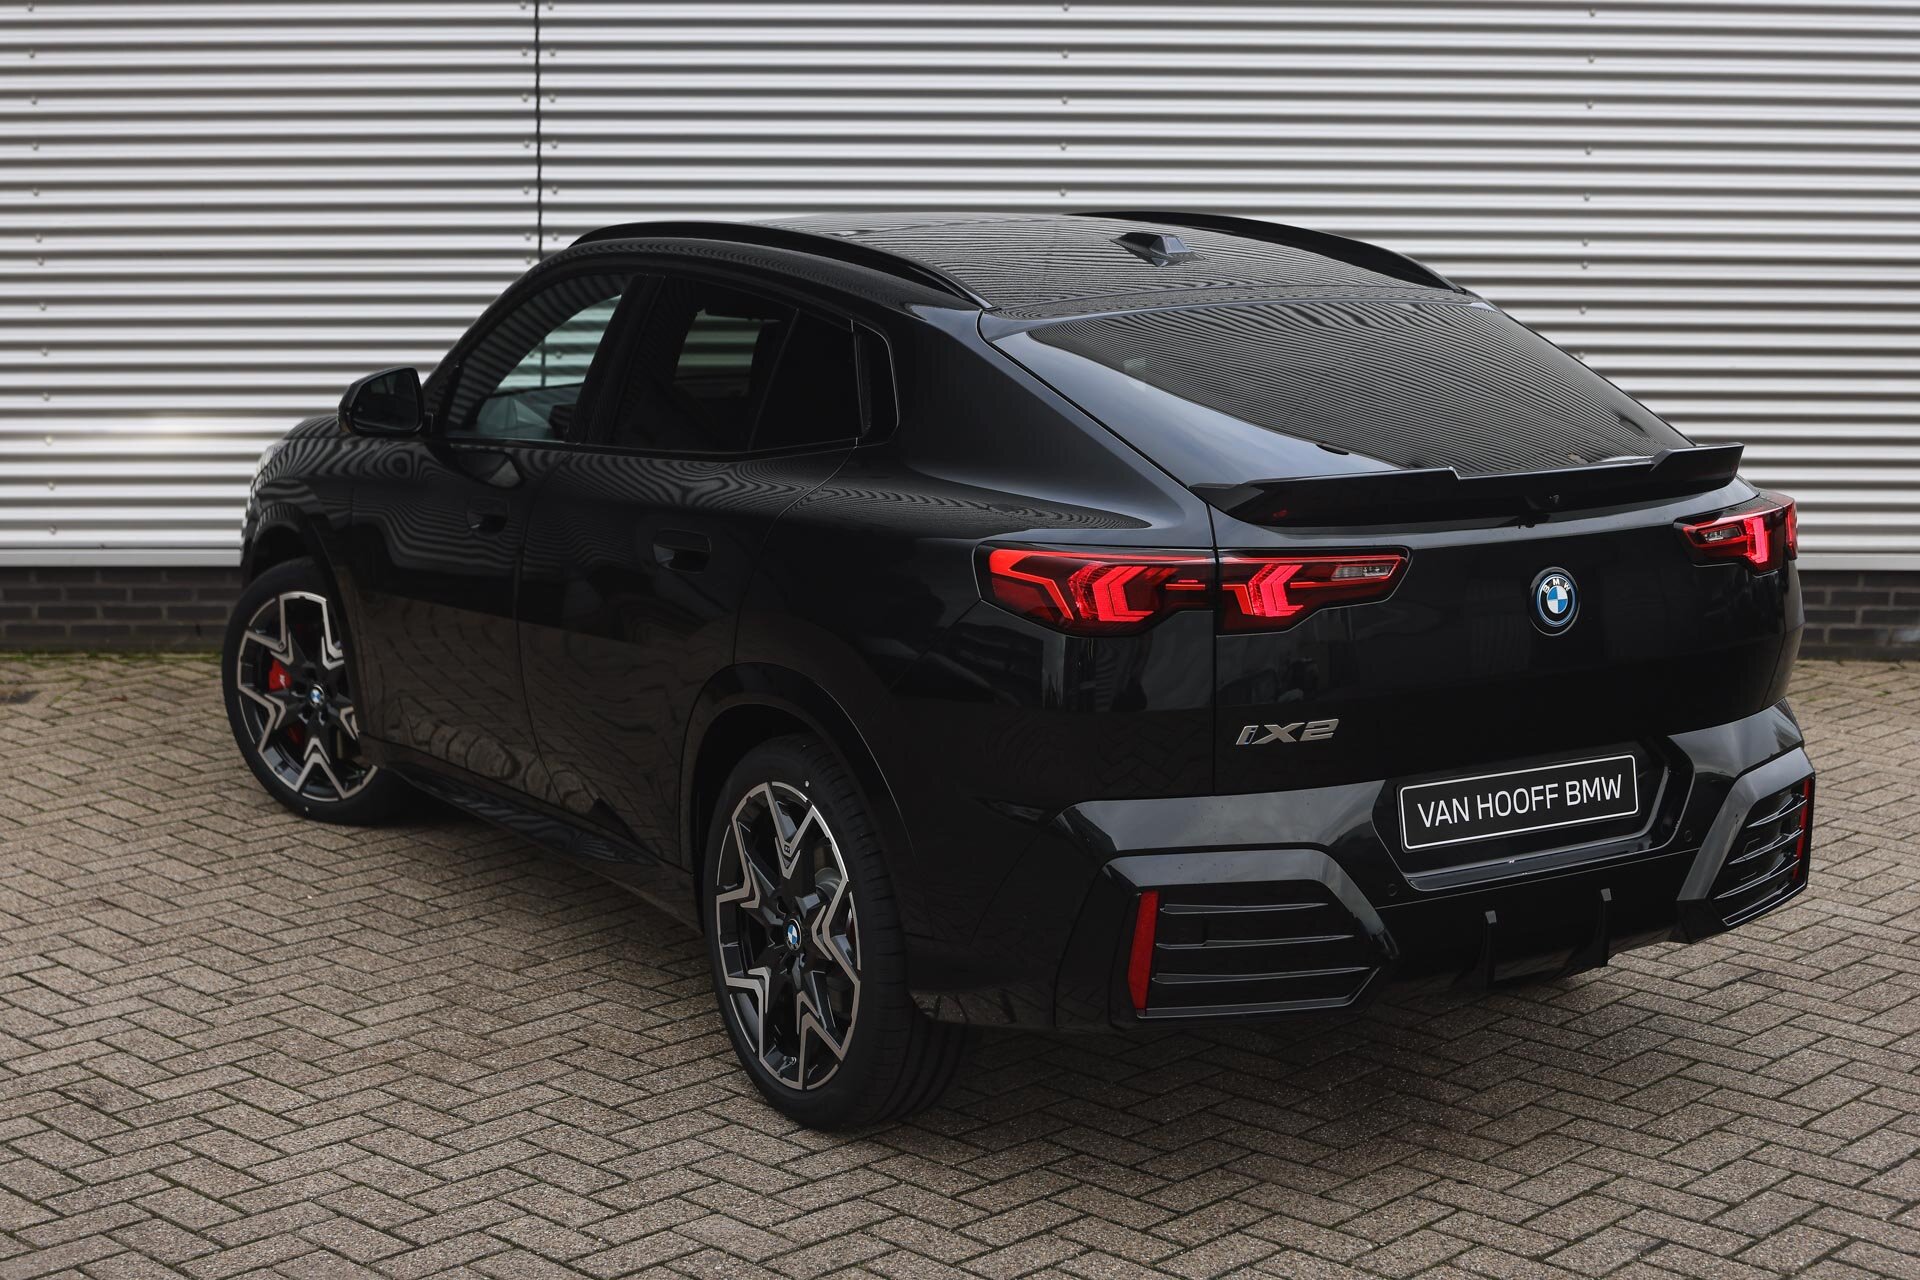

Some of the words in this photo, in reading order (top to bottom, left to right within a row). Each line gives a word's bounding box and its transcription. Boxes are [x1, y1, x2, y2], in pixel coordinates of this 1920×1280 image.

[1542, 578, 1571, 594] BMW
[1236, 719, 1339, 745] iX2
[1417, 796, 1470, 828] VAN
[1476, 783, 1559, 820] HOOFF
[1565, 774, 1622, 806] BMW
